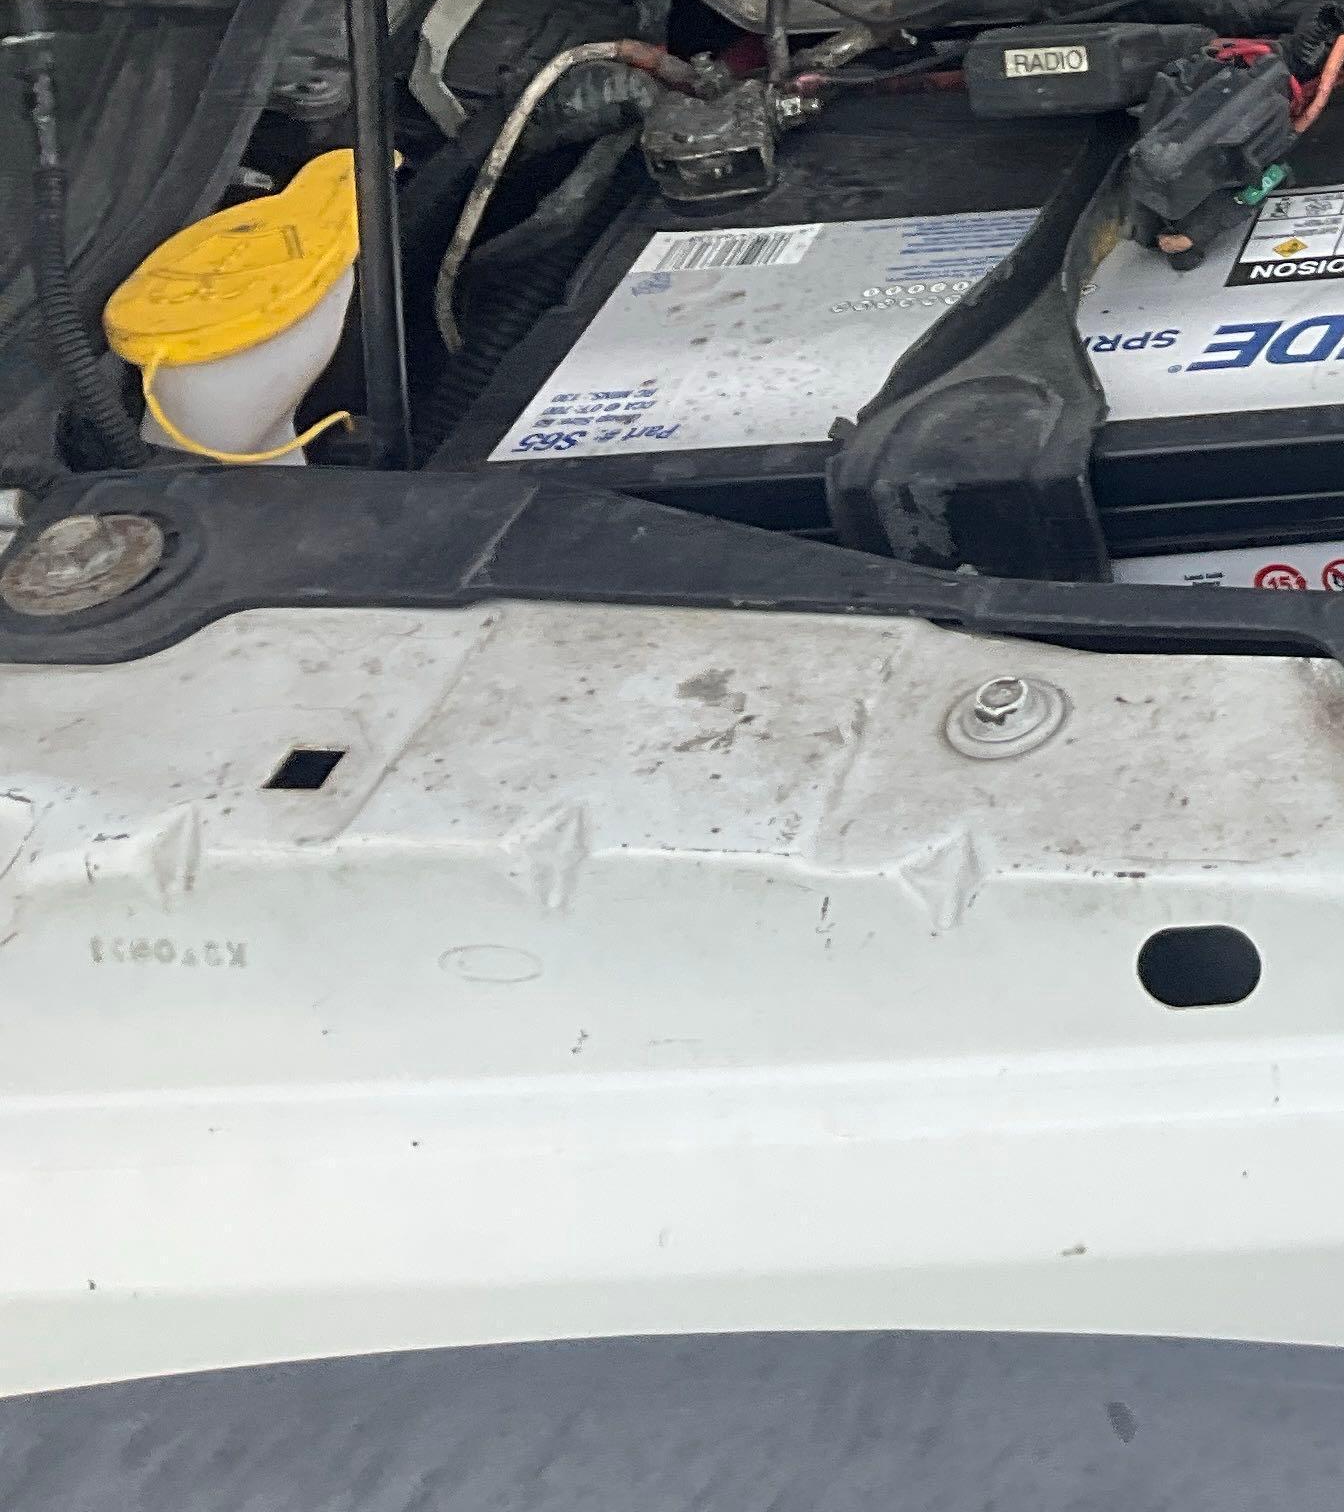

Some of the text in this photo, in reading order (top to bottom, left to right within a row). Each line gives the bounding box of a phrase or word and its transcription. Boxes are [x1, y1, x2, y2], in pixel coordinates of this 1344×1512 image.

[1014, 49, 1083, 73] RADIO
[510, 430, 589, 453] S65
[620, 423, 682, 442] Part
